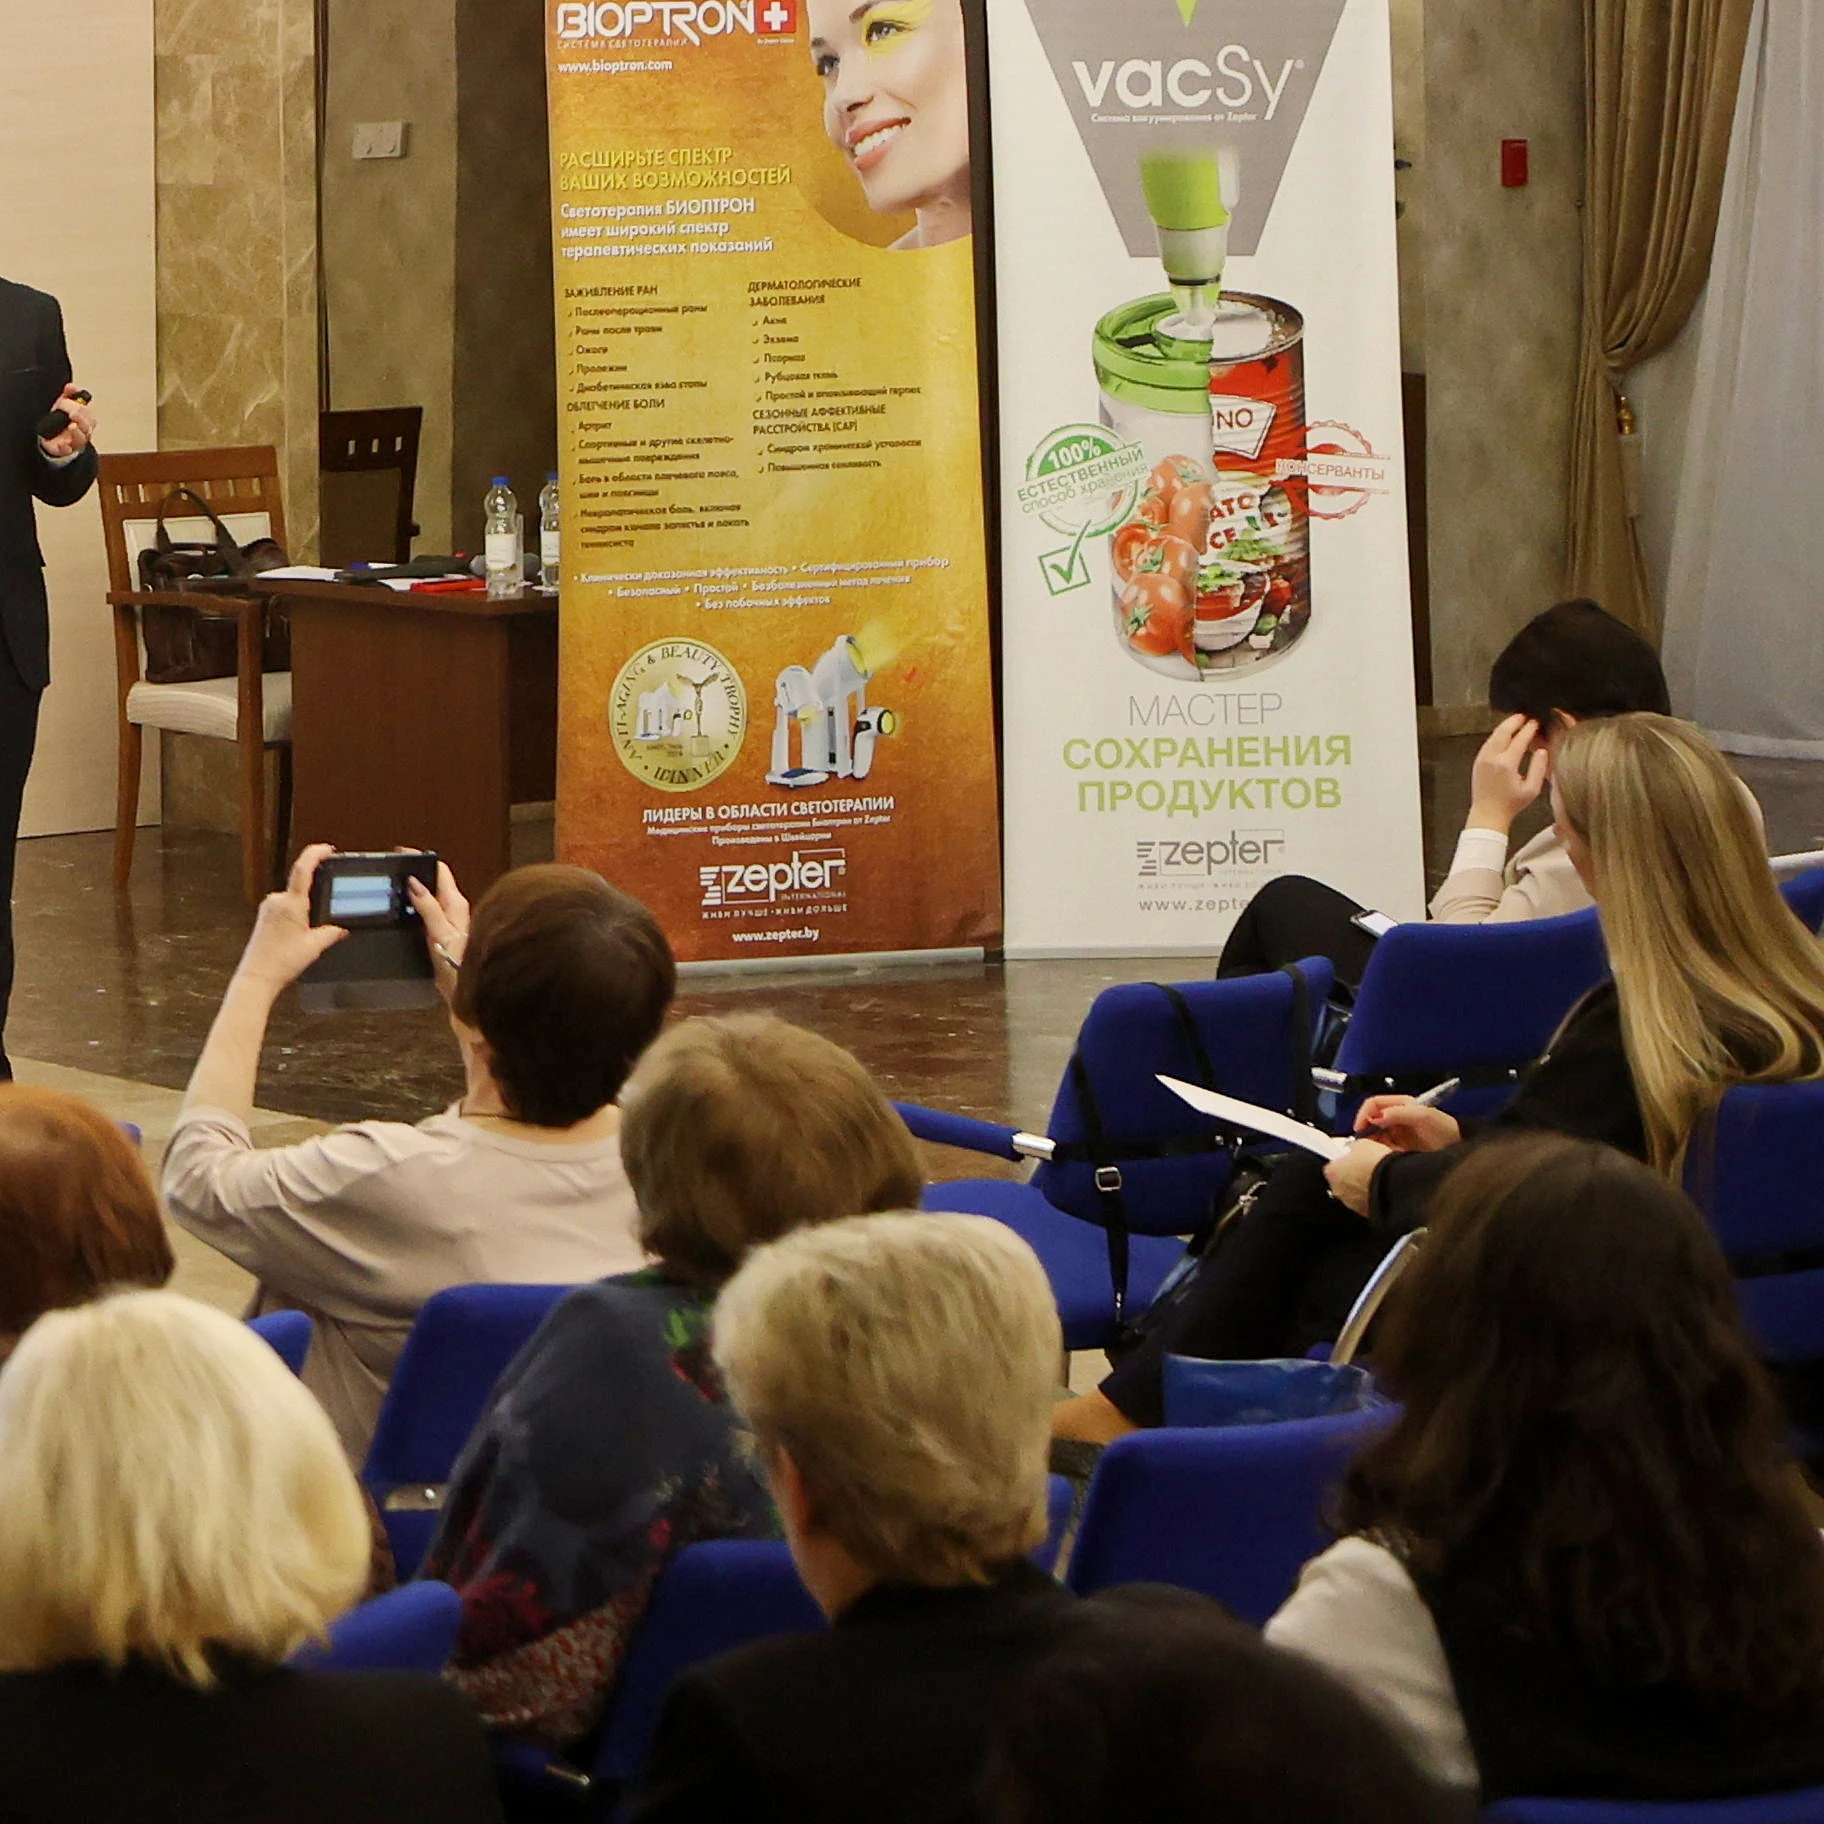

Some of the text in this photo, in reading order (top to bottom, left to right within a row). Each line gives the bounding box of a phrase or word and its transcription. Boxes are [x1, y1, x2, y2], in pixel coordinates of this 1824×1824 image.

[557, 0, 755, 47] BIOPTRON
[558, 59, 672, 74] www.bioptron.com
[1072, 44, 1294, 121] vacSy
[559, 147, 734, 169] РАСШИРЬТЕ СПЕКТР
[560, 164, 792, 191] ВАШИХ ВОЗМОЖНОСТЕЙ
[561, 198, 756, 220] Светотерапия БИОПТРОН
[561, 221, 730, 241] имеет широкий спектр
[561, 237, 774, 261] терапевтических показаний
[1212, 408, 1254, 430] NO
[1048, 437, 1102, 469] 100%
[1017, 448, 1144, 502] ЕСТЕСТВЕННЫЙ
[1129, 693, 1282, 726] МАСТЕР
[1063, 735, 1351, 770] СОХРАНЕНИЯ
[643, 796, 895, 824] ЛИДЕРЫ В ОБЛАСТИ СВЕТОТЕРАПИИ
[1078, 777, 1342, 818] ПРОДУКТОВ
[1159, 830, 1284, 876] zepter
[722, 850, 846, 903] zepter
[1139, 898, 1248, 914] www.zepte
[732, 926, 820, 942] www.zepter.by
